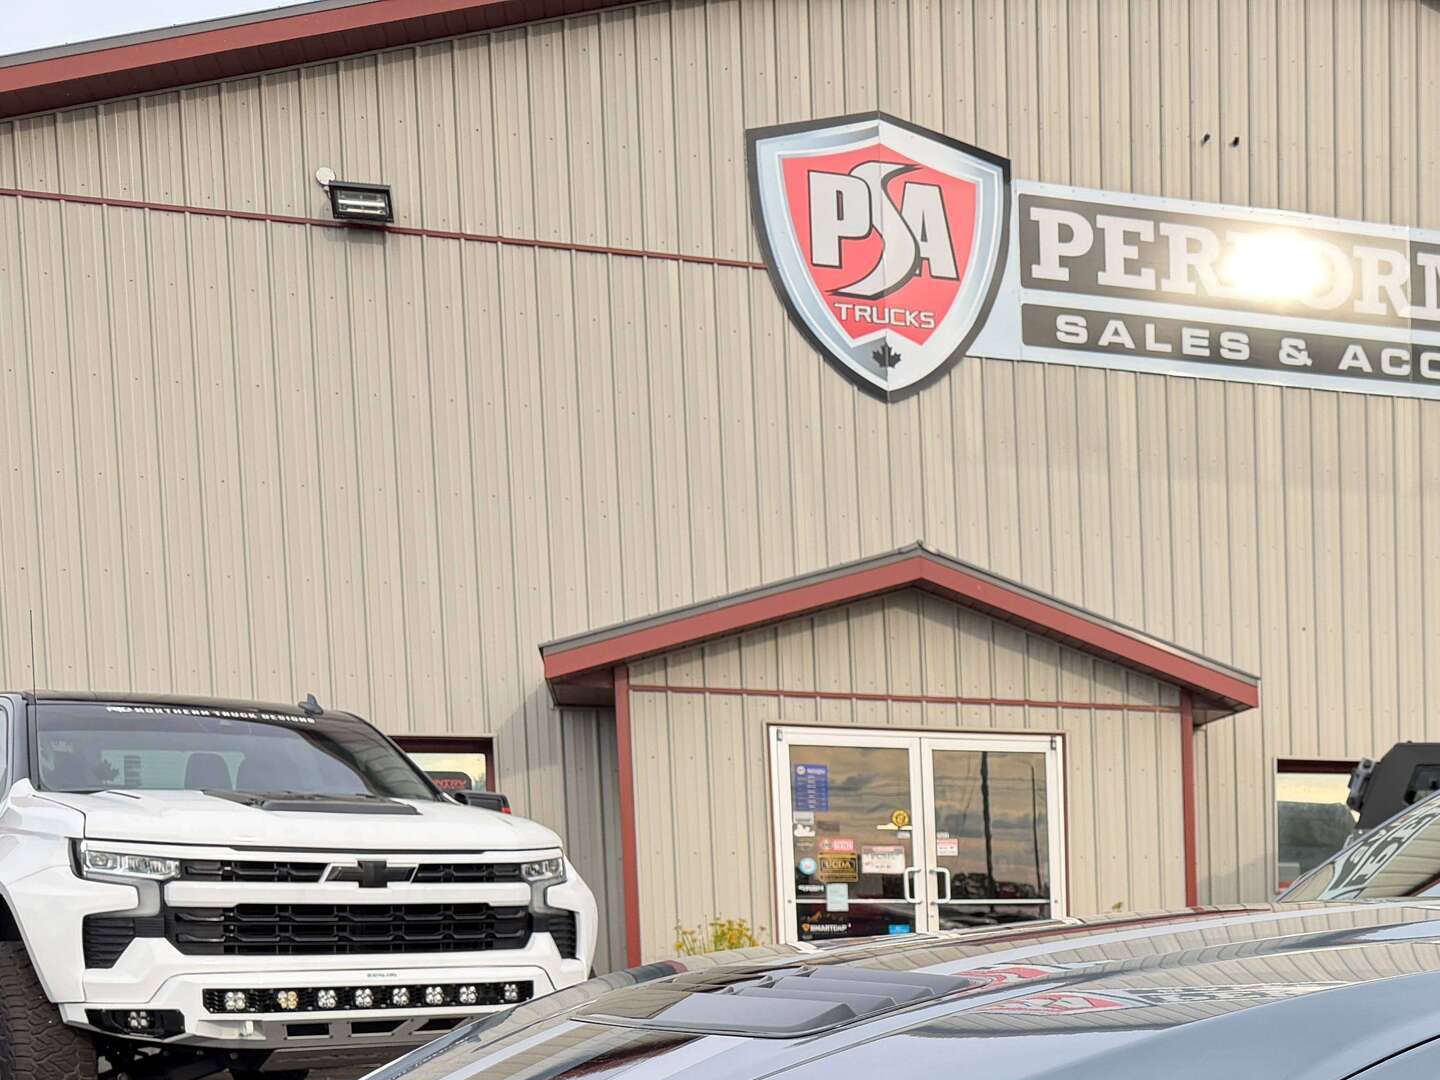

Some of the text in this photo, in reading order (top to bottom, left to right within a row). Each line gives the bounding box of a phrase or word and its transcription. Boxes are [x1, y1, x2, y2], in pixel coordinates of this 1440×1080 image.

[807, 160, 960, 300] PSA
[834, 302, 936, 329] TRUCKS
[1055, 314, 1251, 361] SALES
[1278, 337, 1312, 367] &
[211, 710, 257, 719] TRUCK
[260, 713, 316, 724] DESIGNS
